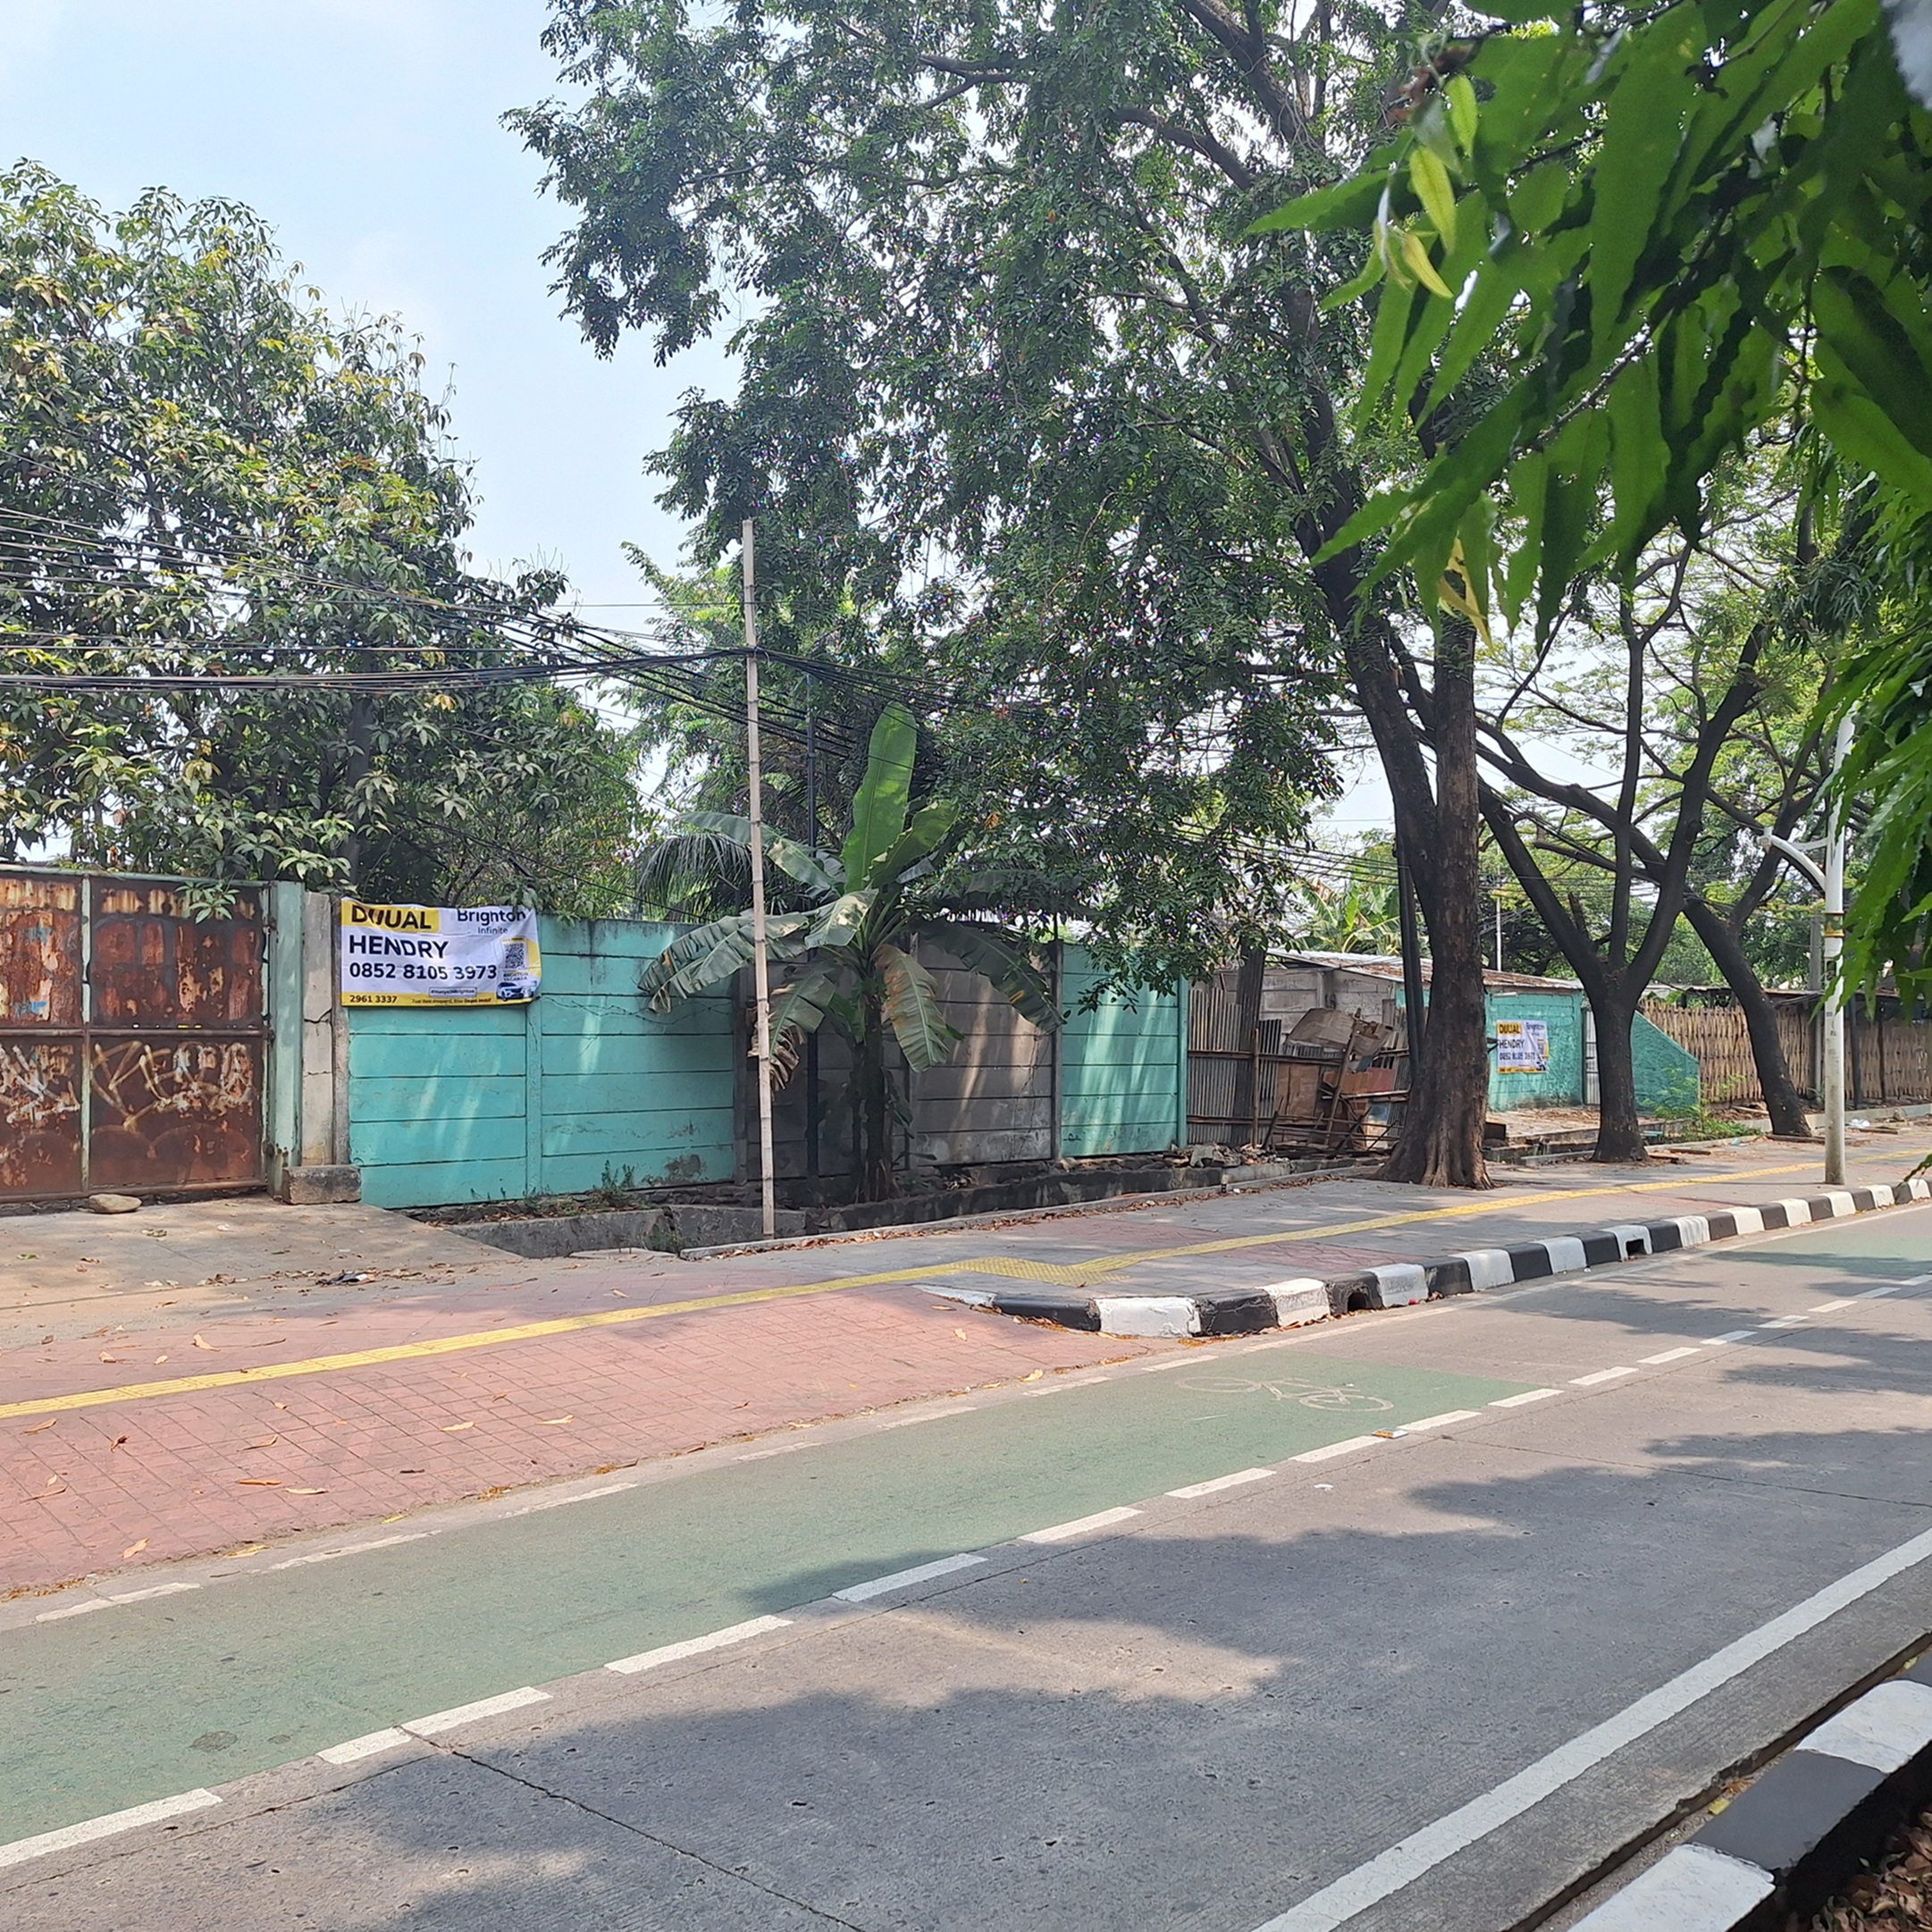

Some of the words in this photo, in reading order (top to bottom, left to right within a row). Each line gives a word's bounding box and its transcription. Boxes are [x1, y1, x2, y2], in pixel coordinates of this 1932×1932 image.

[458, 910, 526, 926] Brighton
[478, 927, 508, 935] Infinite
[349, 935, 449, 959] HENDRY
[349, 962, 396, 979] 0852
[403, 963, 449, 980] 8105
[453, 964, 498, 980] 3973
[349, 995, 373, 1003] 2961
[375, 995, 398, 1004] 3337
[1499, 1039, 1525, 1048] HENDRY
